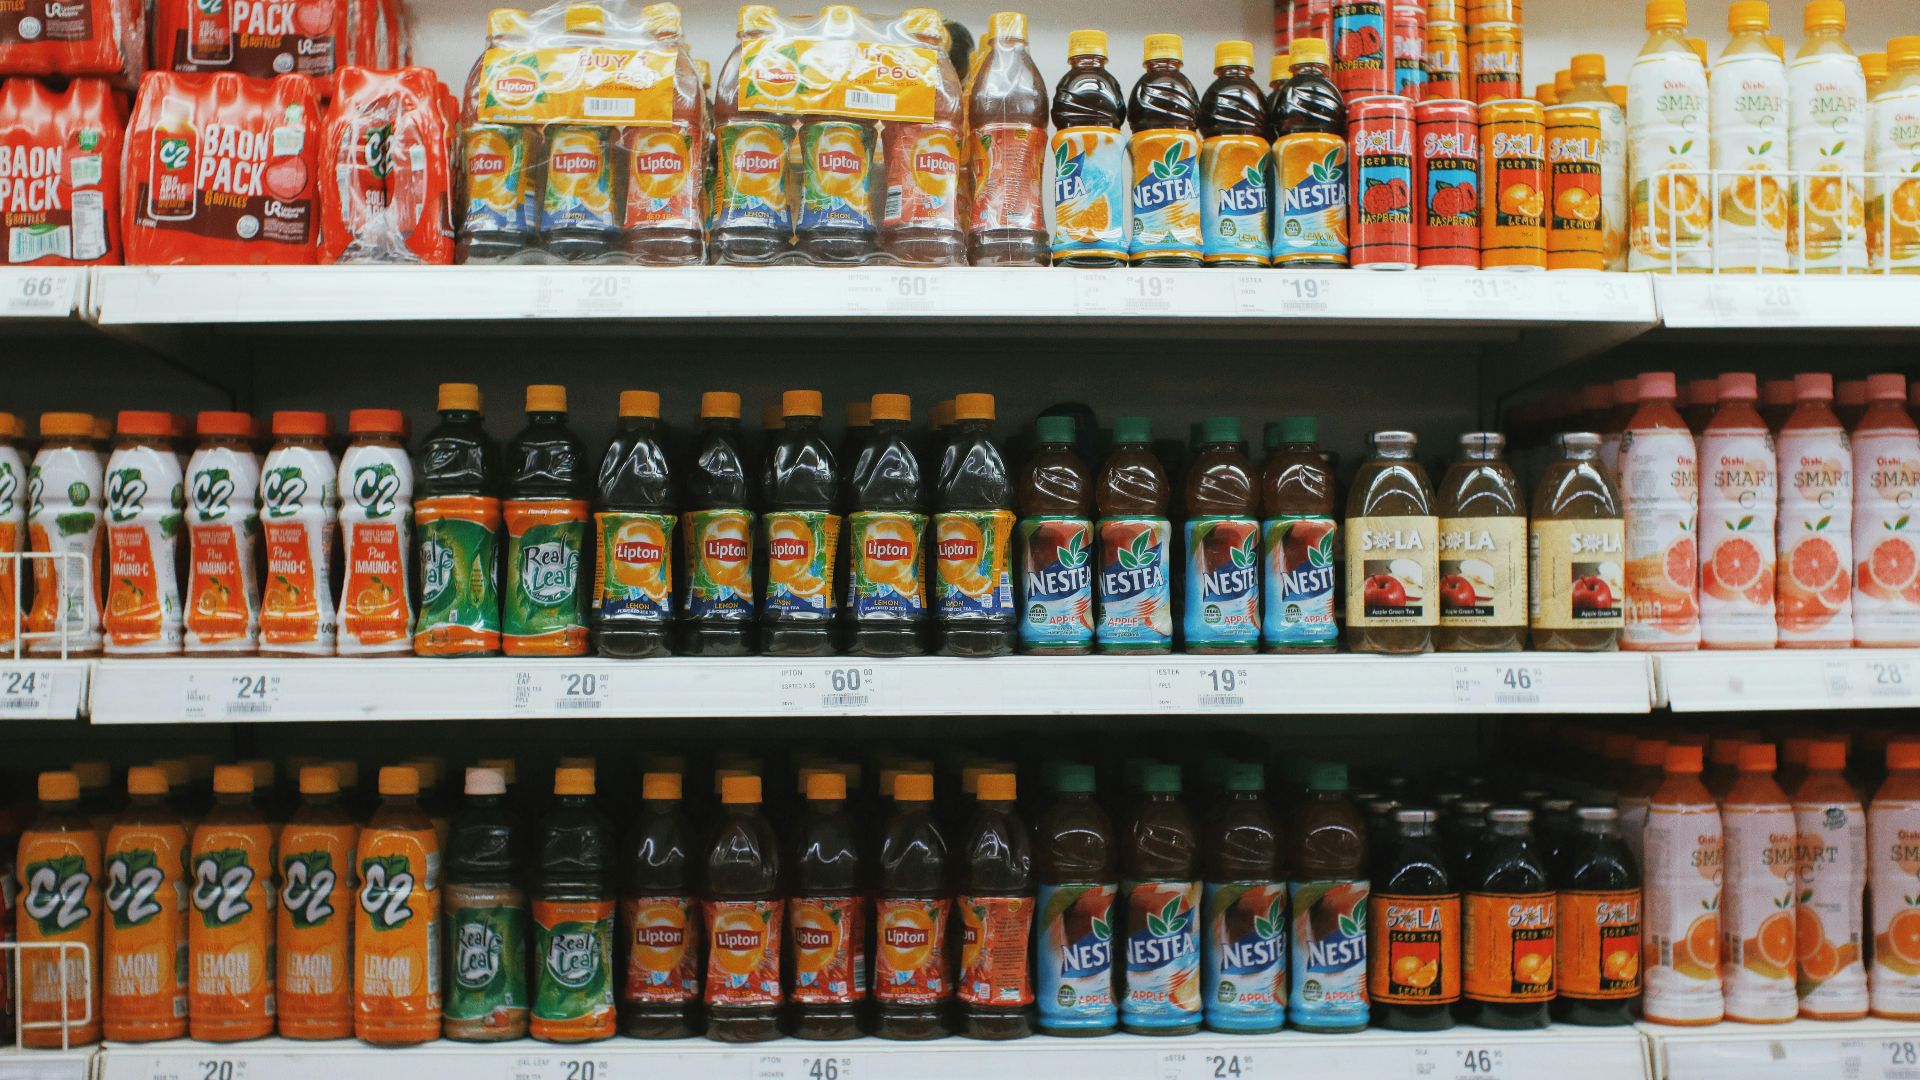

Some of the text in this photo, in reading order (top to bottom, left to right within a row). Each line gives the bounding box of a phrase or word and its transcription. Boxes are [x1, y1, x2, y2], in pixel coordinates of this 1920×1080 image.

[233, 2, 295, 35] PACK
[250, 39, 281, 49] BOTTLES
[580, 54, 627, 68] BUY
[756, 70, 802, 83] Lipton
[498, 80, 536, 94] Lipton
[205, 124, 270, 162] BAON
[0, 145, 63, 178] BAON
[160, 141, 191, 168] C2
[556, 154, 596, 171] Lipton
[641, 157, 682, 174] Lipton
[737, 158, 779, 173] Lipton
[821, 157, 860, 173] Lipton
[920, 157, 957, 174] Lipton
[198, 157, 266, 196] PACK
[213, 194, 248, 208] BOTTLES
[1361, 213, 1410, 225] RASPBERRY
[1430, 215, 1478, 228] RASPBERRY
[1507, 215, 1541, 227] LEMON
[1562, 219, 1597, 230] LEMON
[24, 277, 53, 297] 66
[1135, 277, 1162, 298] 19
[1290, 278, 1317, 299] 19
[1721, 456, 1744, 466] Oishi
[1800, 456, 1822, 466] Oishi
[1877, 457, 1900, 466] Oishi
[1714, 471, 1776, 488] SMART
[108, 474, 148, 517] C2
[193, 474, 234, 516] C2
[263, 473, 309, 514] C2
[353, 470, 400, 515] C2
[1738, 492, 1757, 510] C
[1818, 492, 1835, 510] C
[1896, 491, 1913, 510] C
[1362, 528, 1423, 551] SOLA
[368, 546, 386, 561] Plus
[525, 531, 567, 573] Real
[708, 541, 746, 558] Lipton
[868, 542, 908, 559] Lipton
[939, 542, 974, 558] Lipton
[355, 561, 397, 575] IMMUNO-C
[532, 551, 580, 591] Leaf
[1029, 566, 1091, 597] NESTEA
[874, 600, 899, 608] LEMON
[1372, 608, 1388, 616] Apple
[1049, 616, 1076, 625] APPLE
[1107, 617, 1138, 627] APPLE
[1581, 610, 1597, 618] Apple
[8, 672, 36, 694] 24
[832, 668, 861, 691] 60
[1208, 669, 1236, 692] 19
[1503, 668, 1532, 689] 46
[1873, 664, 1902, 685] 28
[237, 675, 267, 699] 24
[567, 674, 597, 696] 20
[25, 867, 91, 928] C2
[107, 860, 162, 922] C2
[193, 860, 252, 922] C2
[283, 862, 335, 923] C2
[360, 864, 413, 926] C2
[459, 918, 490, 949] Real
[638, 929, 681, 947] Lipton
[719, 932, 758, 949] Lipton
[887, 929, 926, 946] Lipton
[1421, 932, 1439, 941] TEA
[549, 932, 592, 956] Real
[460, 933, 503, 974] Leaf
[559, 943, 601, 975] Leaf
[364, 955, 410, 978] LEMON
[1131, 991, 1165, 1001] APPLE
[1398, 986, 1432, 996] LEMON
[1522, 984, 1549, 994] LEMON
[1464, 1050, 1492, 1073] 46
[1888, 1041, 1917, 1065] 28
[1213, 1056, 1241, 1078] 24
